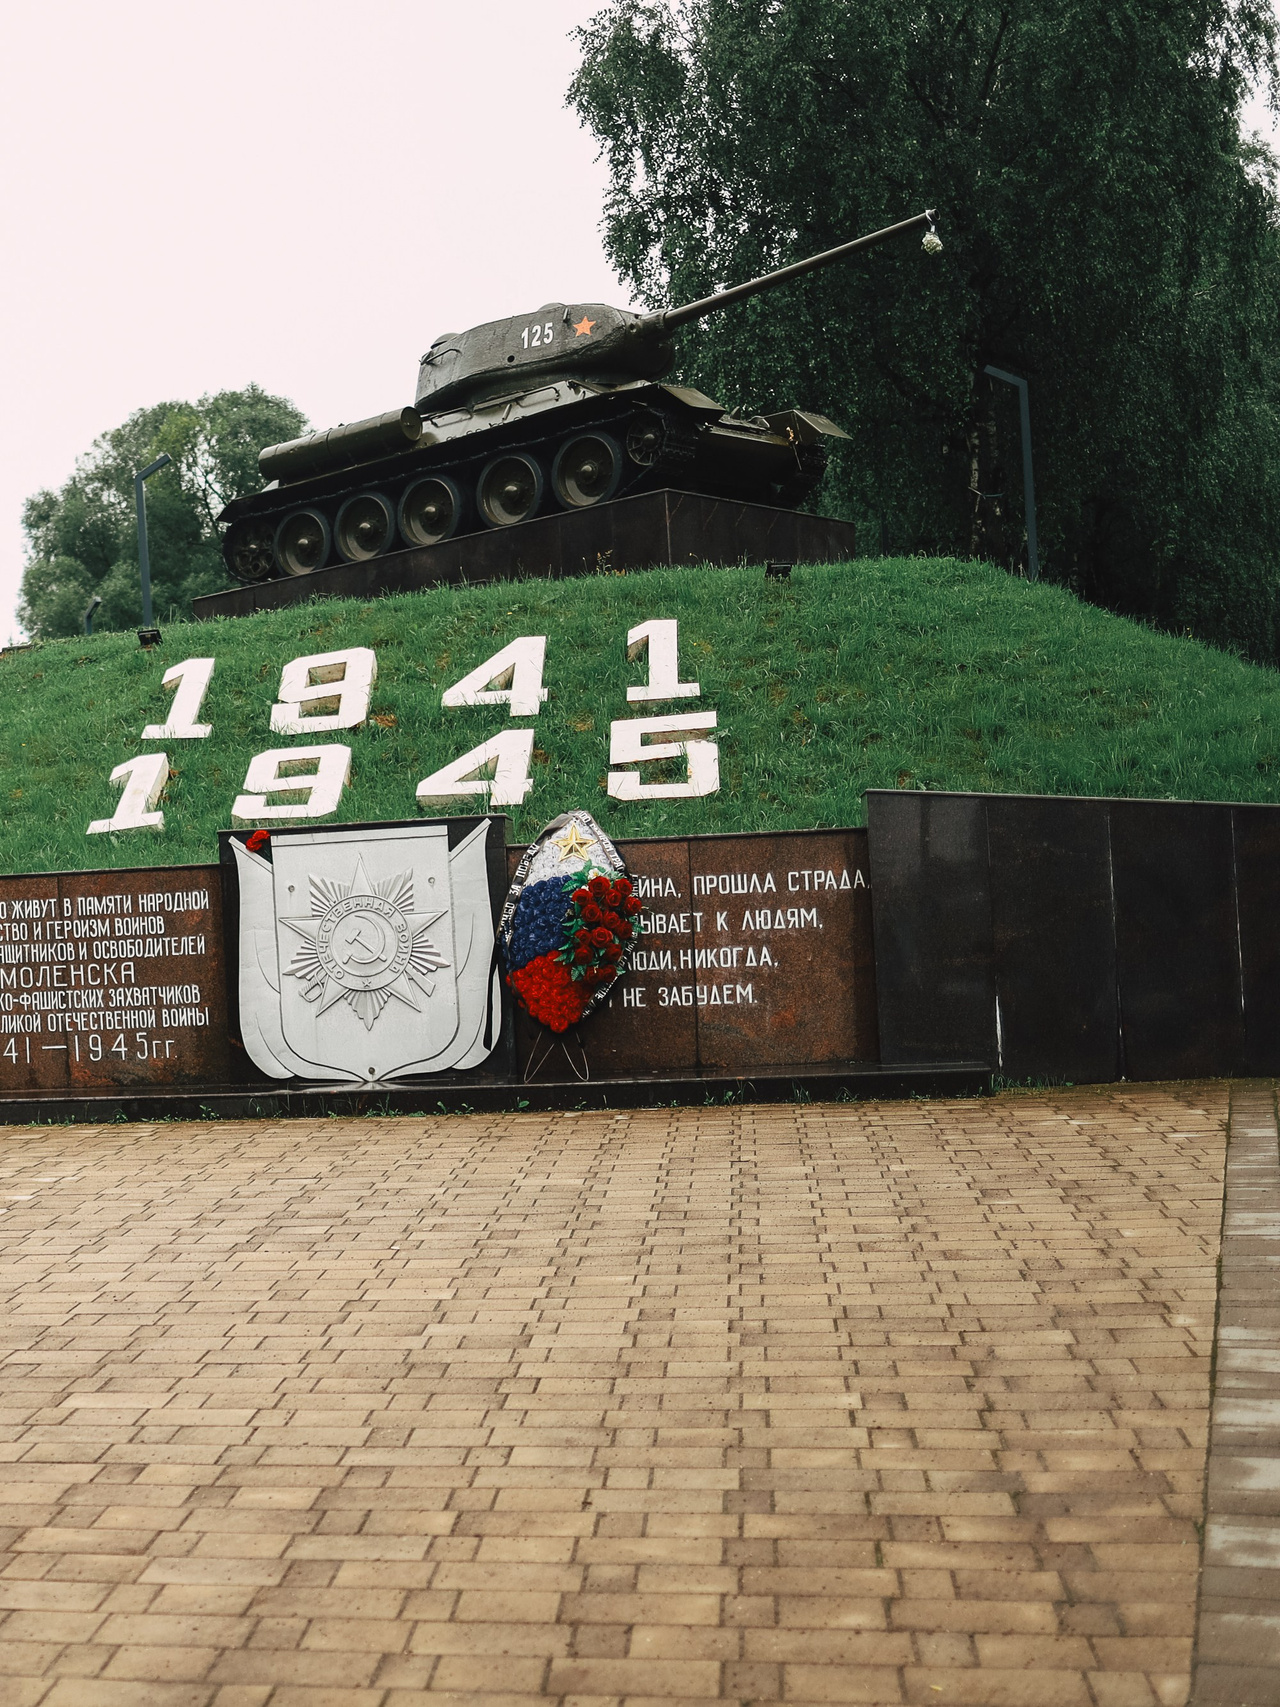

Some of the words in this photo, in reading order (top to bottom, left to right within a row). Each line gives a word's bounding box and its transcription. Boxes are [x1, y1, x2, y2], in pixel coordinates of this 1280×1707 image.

[521, 322, 554, 349] 125
[141, 619, 701, 739] 1941
[86, 711, 720, 834] 1945
[508, 884, 522, 896] ЗА
[638, 875, 681, 898] ЙНА,
[694, 872, 776, 895] ПРОШЛА
[12, 899, 56, 918] ЖИВУТ
[63, 898, 71, 916] В
[78, 894, 132, 915] ПАМЯТИ
[139, 888, 209, 912] НАРОДНОЙ
[33, 921, 41, 939] И
[47, 920, 110, 939] ГЕРОИЗМ
[115, 916, 165, 936] ВОИНОВ
[641, 912, 702, 936] ЫВАЕТ
[717, 911, 728, 931] К
[742, 908, 823, 930] ЛЮДЯМ,
[79, 941, 87, 960] И
[93, 933, 205, 958] ОСВОБОДИТЕЛЕЙ
[319, 896, 396, 980] ОТЕЧЕСТВЕННАЯ
[680, 946, 779, 968] НИКОГДА,
[109, 984, 200, 1006] ЗАХВАТЧИКОВ
[623, 987, 646, 1008] НЕ
[658, 984, 758, 1006] ЗАБУДЕМ.
[47, 1007, 156, 1031] ОТЕЧЕСТВЕННОЙ
[162, 1006, 209, 1027] ВОЙНЫ
